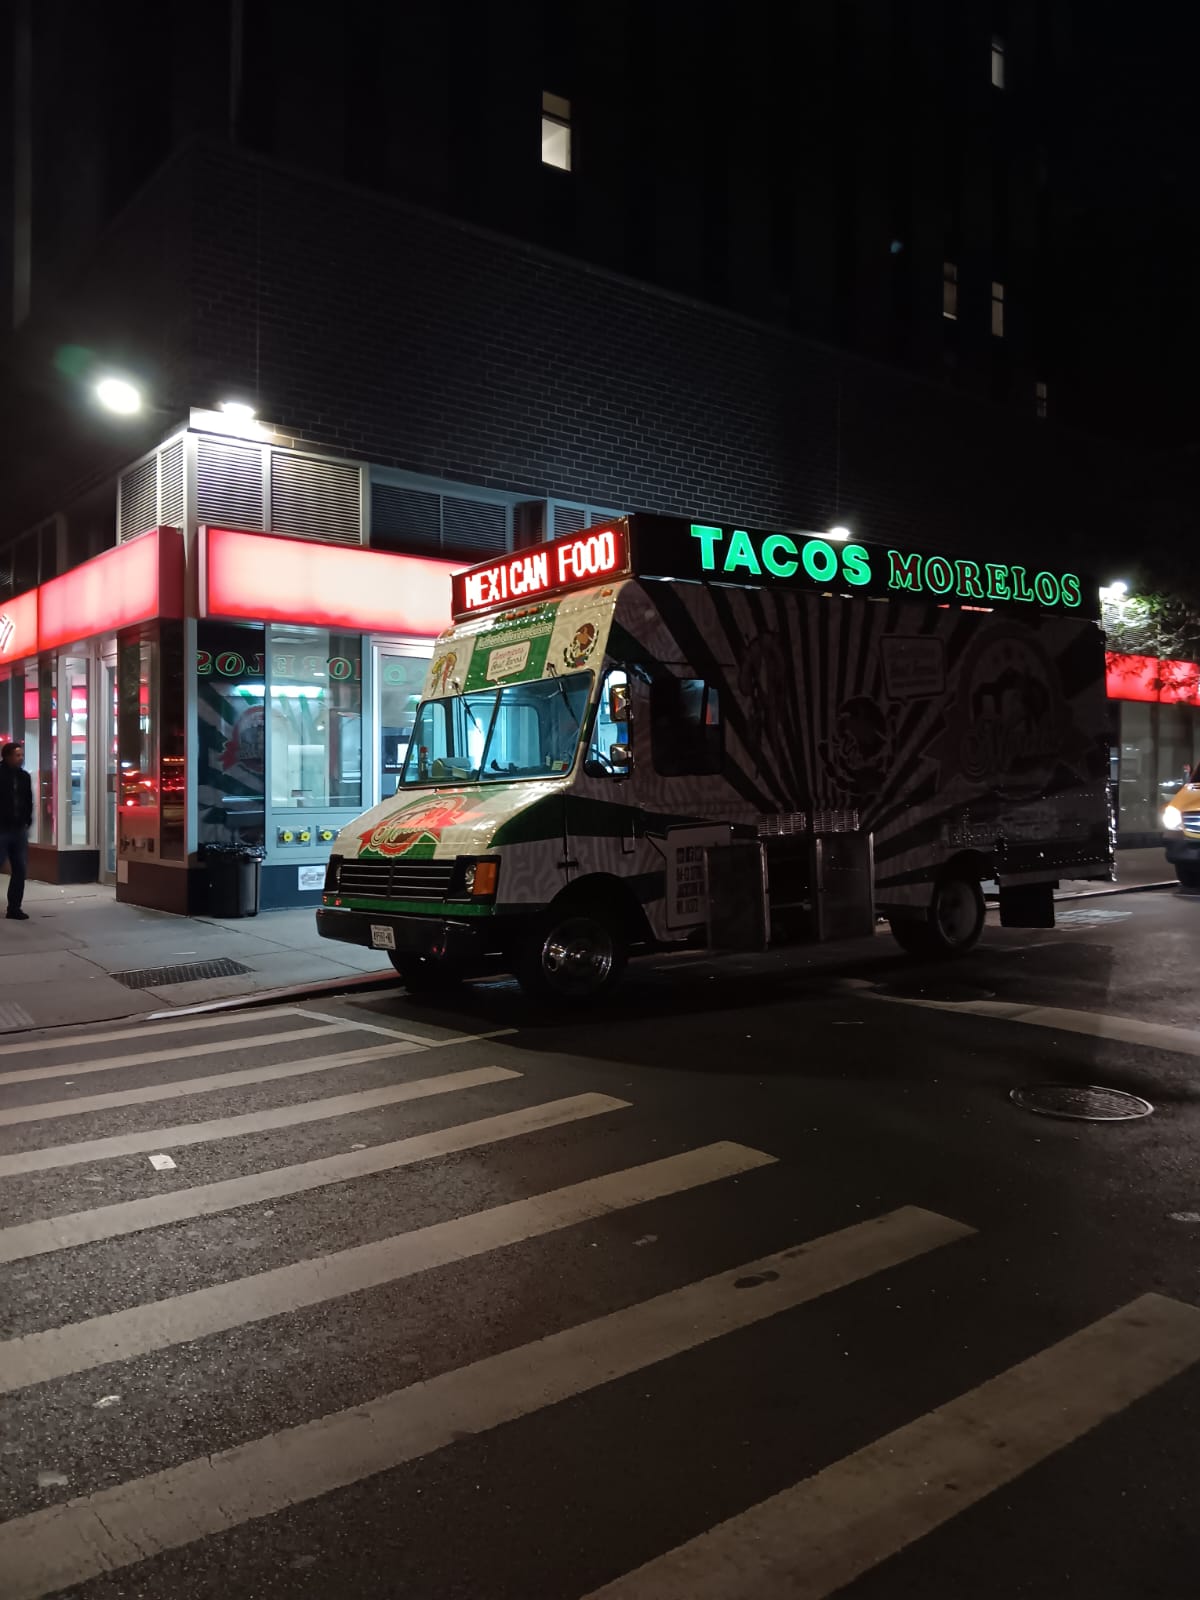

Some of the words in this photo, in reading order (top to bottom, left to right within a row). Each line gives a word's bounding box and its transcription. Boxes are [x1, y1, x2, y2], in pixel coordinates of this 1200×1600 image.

[465, 552, 549, 609] MEXICAN
[558, 531, 616, 582] FOOD
[690, 524, 872, 586] TACOS
[888, 550, 1082, 608] MORELOS
